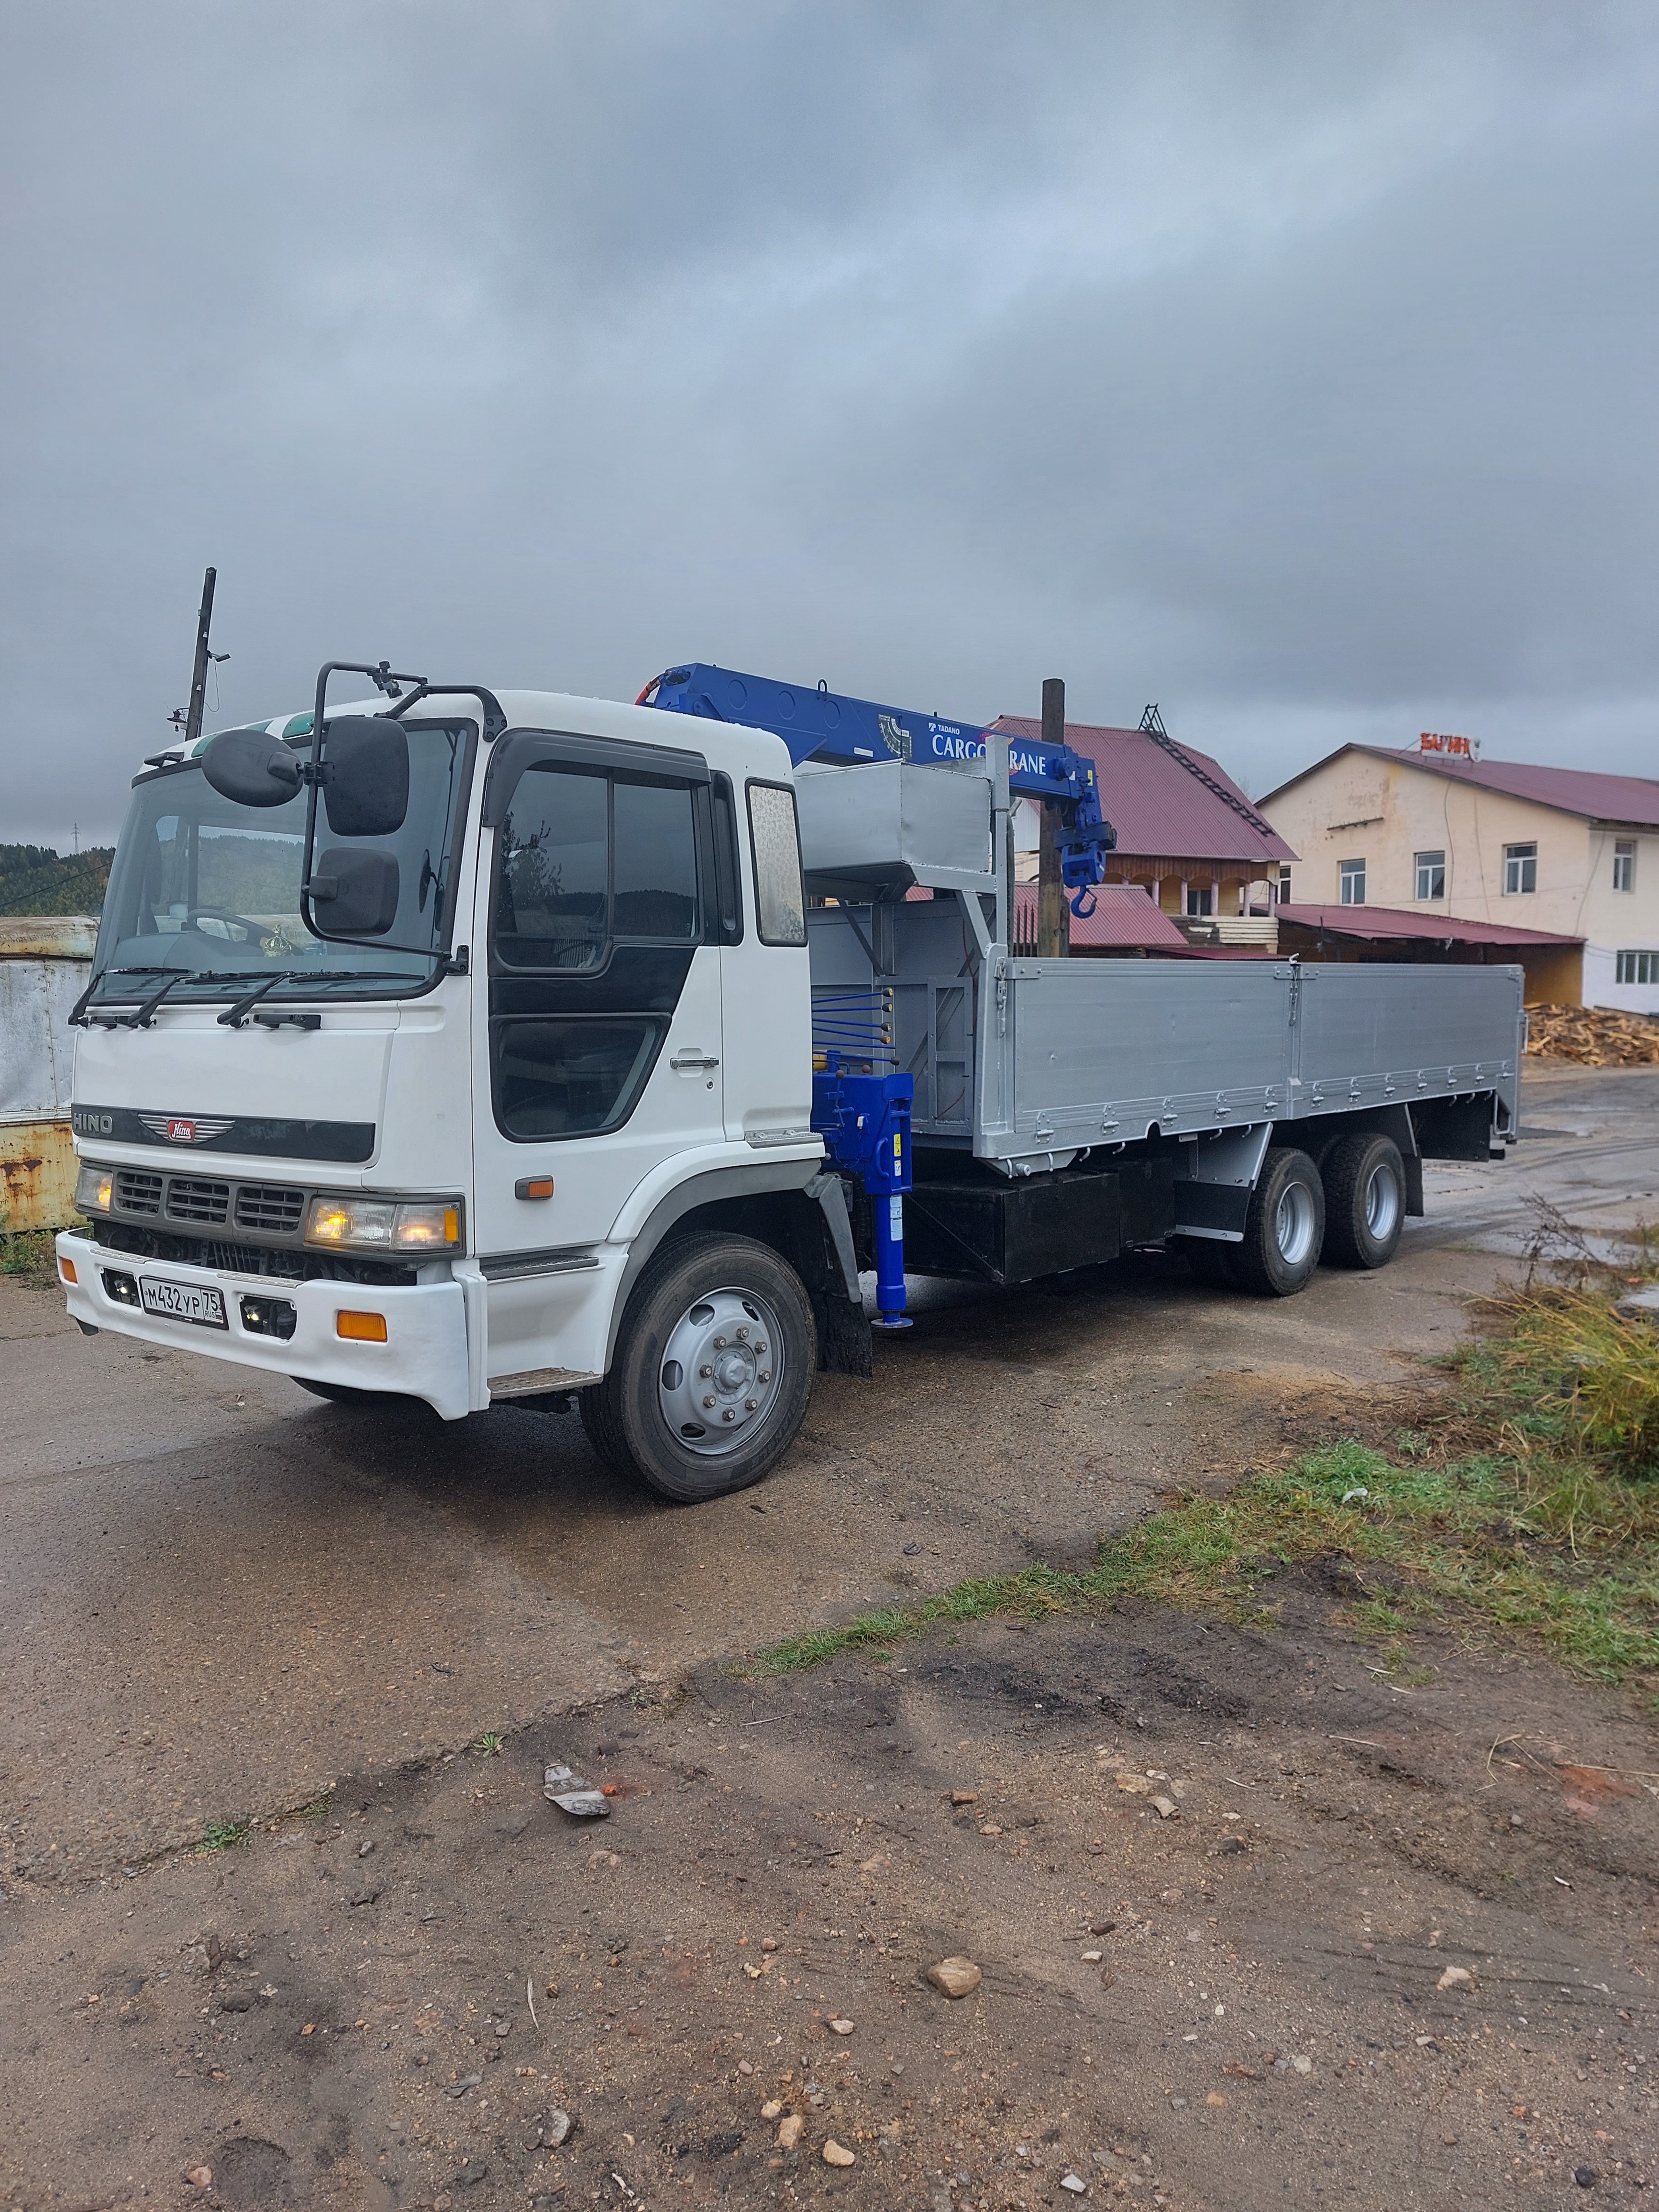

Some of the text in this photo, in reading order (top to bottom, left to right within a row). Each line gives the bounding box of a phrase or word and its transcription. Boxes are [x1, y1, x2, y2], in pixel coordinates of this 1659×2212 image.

[938, 724, 960, 735] TADANO
[1009, 750, 1047, 776] RANE
[73, 1113, 112, 1134] HINO
[172, 1122, 191, 1139] Hino
[147, 1285, 218, 1315] М432УР 75
[205, 1310, 215, 1318] RUS
